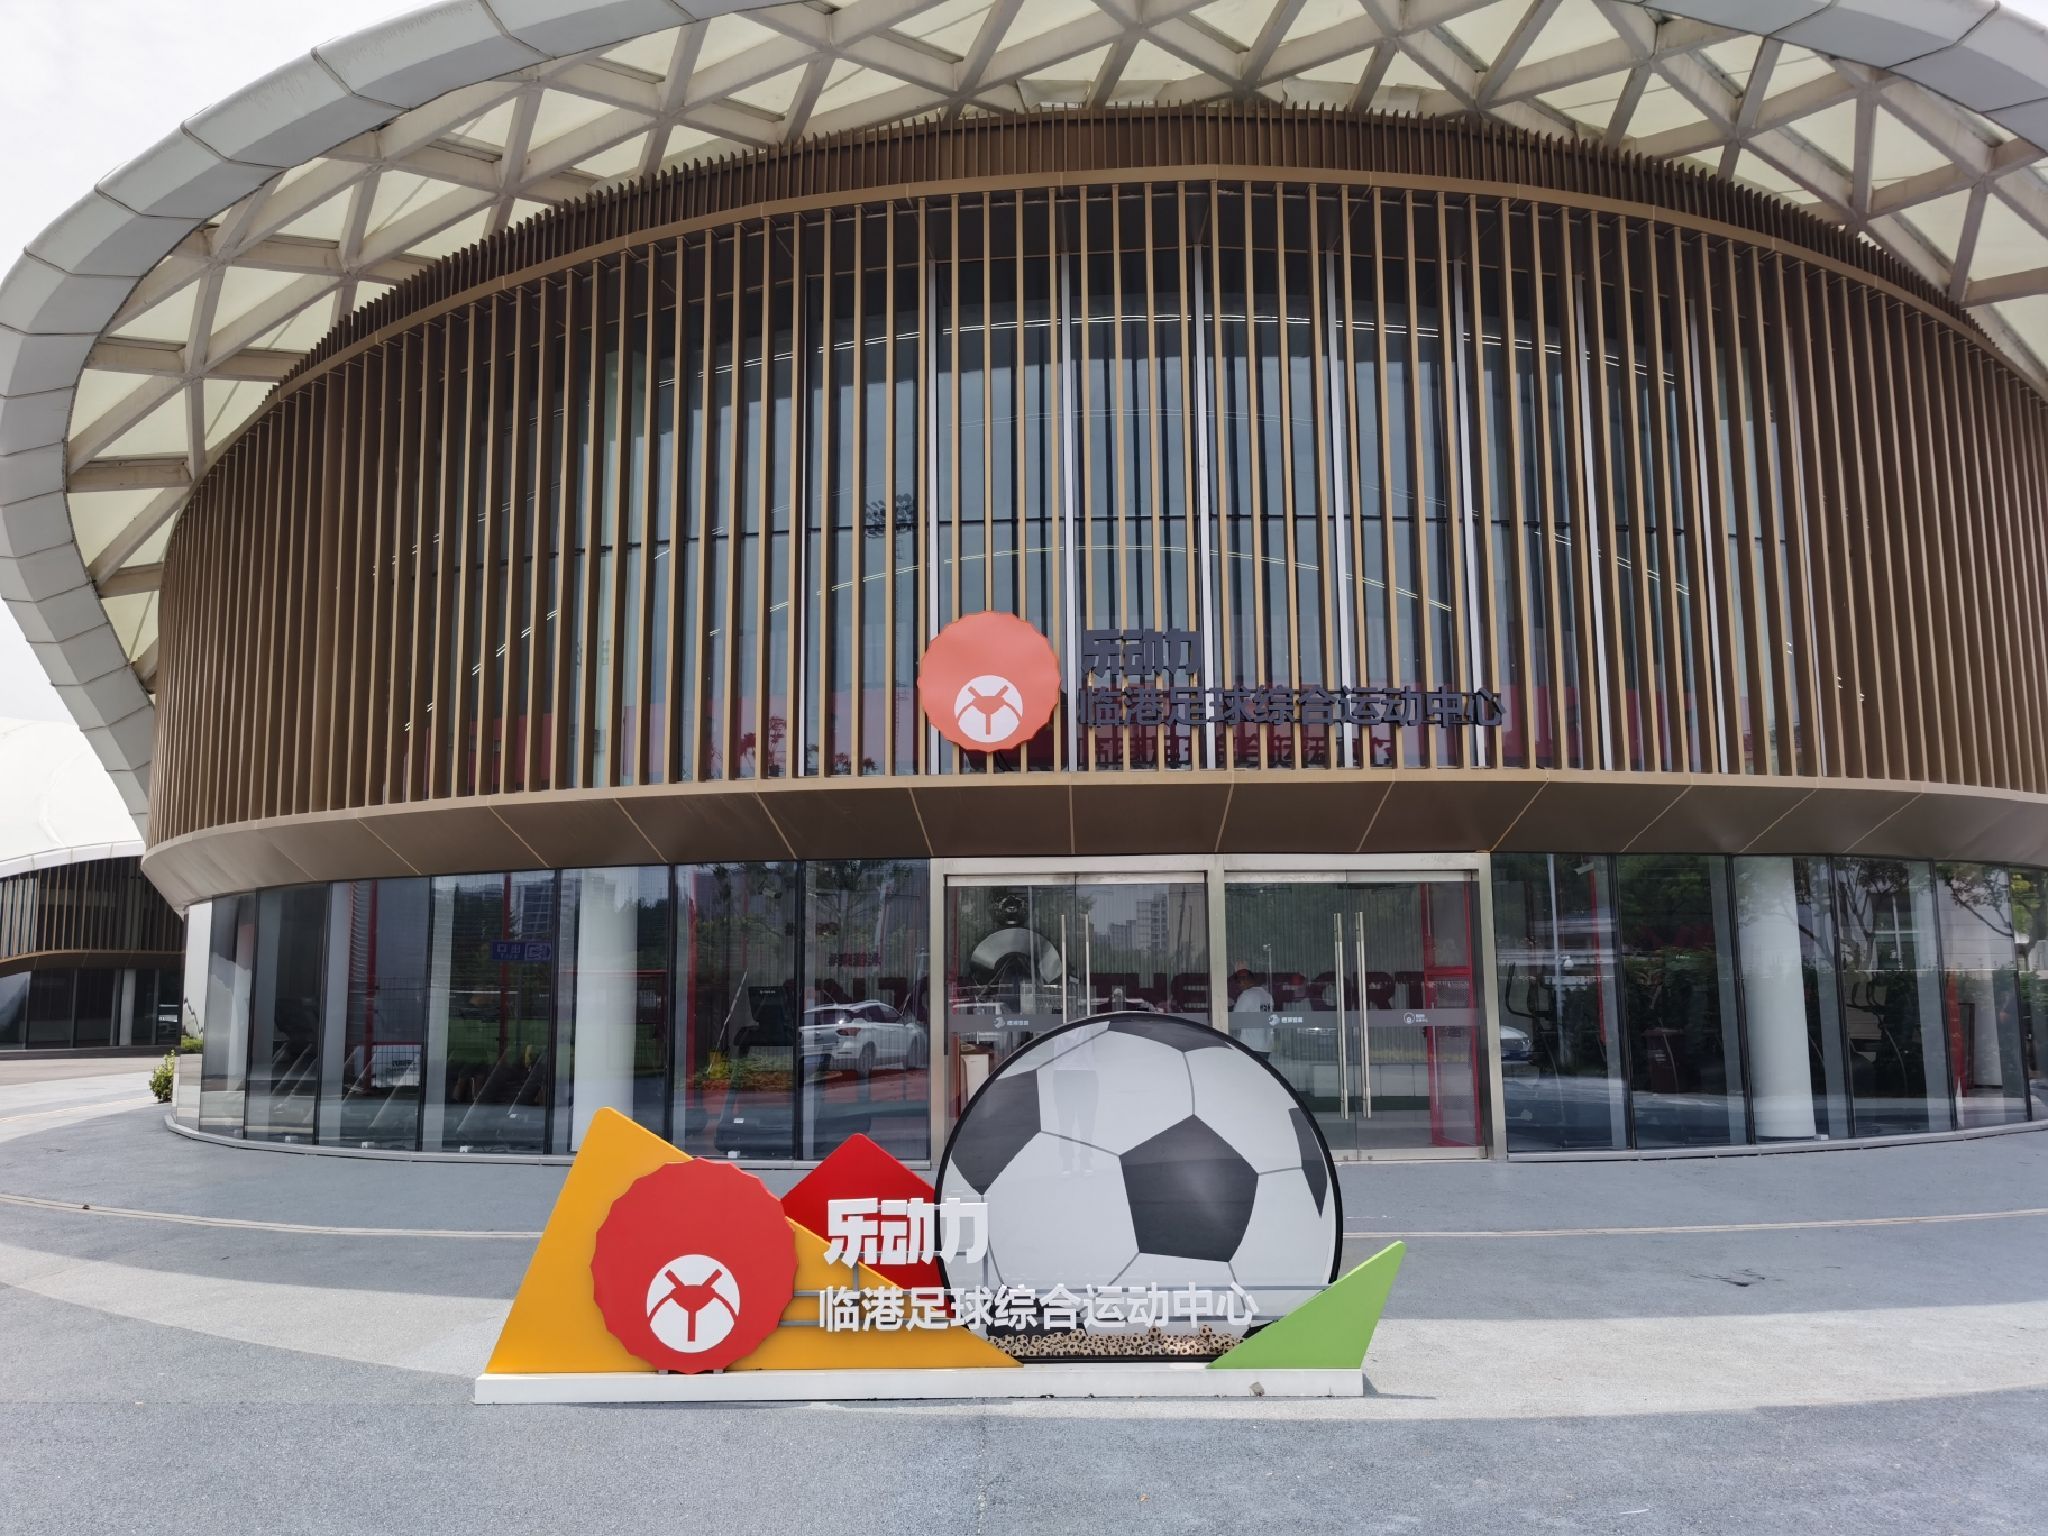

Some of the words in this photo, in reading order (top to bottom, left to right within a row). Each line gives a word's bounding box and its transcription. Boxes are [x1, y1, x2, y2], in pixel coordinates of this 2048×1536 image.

[1081, 629, 1200, 678] 乐动力
[1079, 685, 1507, 727] 临港足球综合运动中心
[824, 1197, 988, 1267] 乐动力
[819, 1281, 1259, 1332] 临港足球综合运动中心
